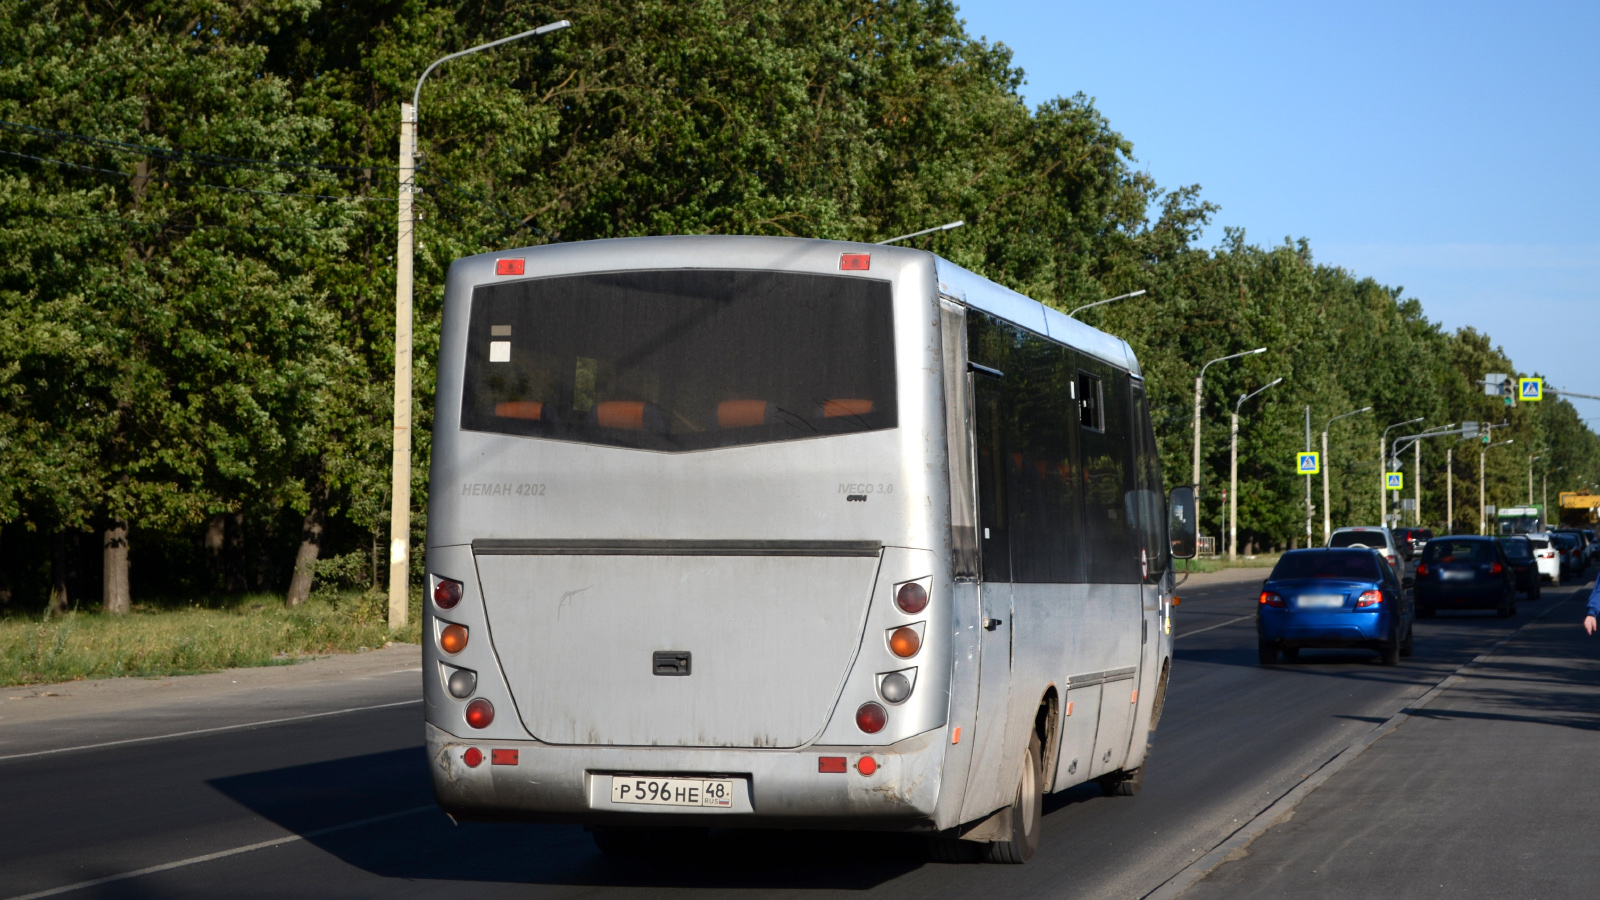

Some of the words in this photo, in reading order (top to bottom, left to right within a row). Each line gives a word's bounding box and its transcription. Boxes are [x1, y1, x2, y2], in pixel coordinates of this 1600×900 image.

[462, 483, 512, 496] НЕМАН
[515, 483, 546, 496] 4202
[838, 483, 874, 494] IVECO
[877, 483, 894, 494] 3.0
[705, 782, 725, 798] 48
